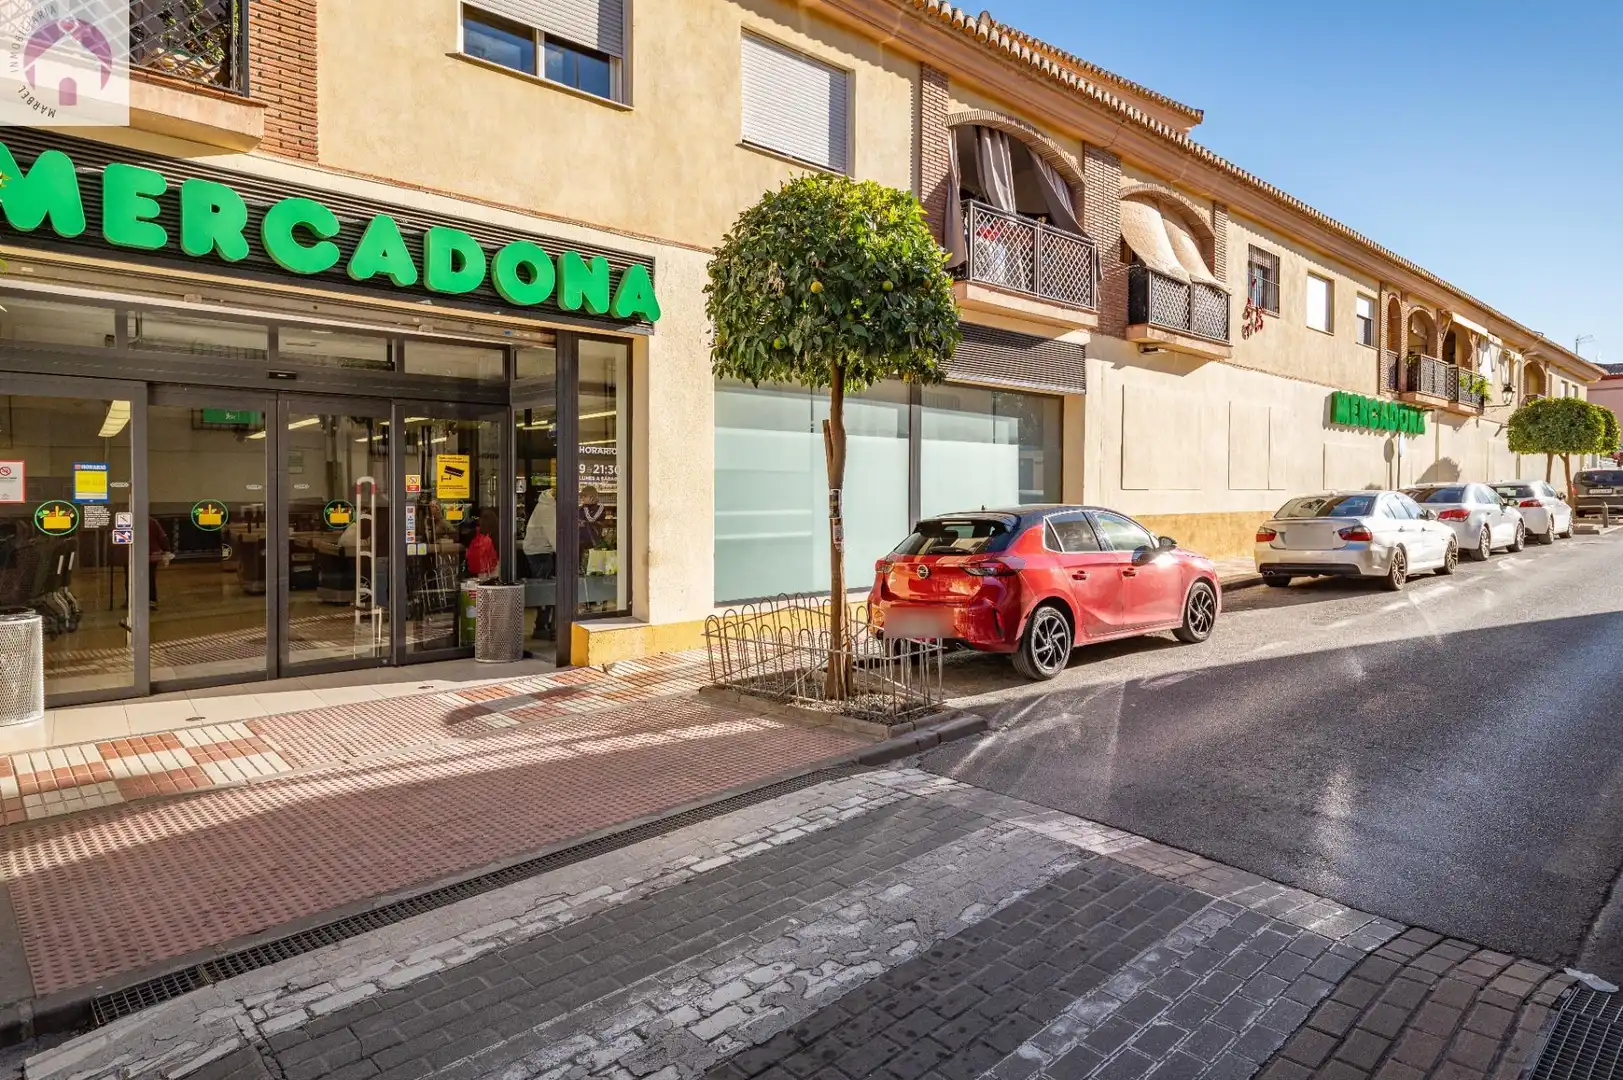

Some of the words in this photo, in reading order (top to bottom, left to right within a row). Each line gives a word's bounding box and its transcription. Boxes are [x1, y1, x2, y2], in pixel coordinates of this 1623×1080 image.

[0, 140, 661, 323] MERCADONA
[1331, 391, 1425, 435] MERCADONA
[579, 446, 617, 455] HORARIO
[579, 464, 586, 474] 9
[593, 464, 621, 475] 21:30
